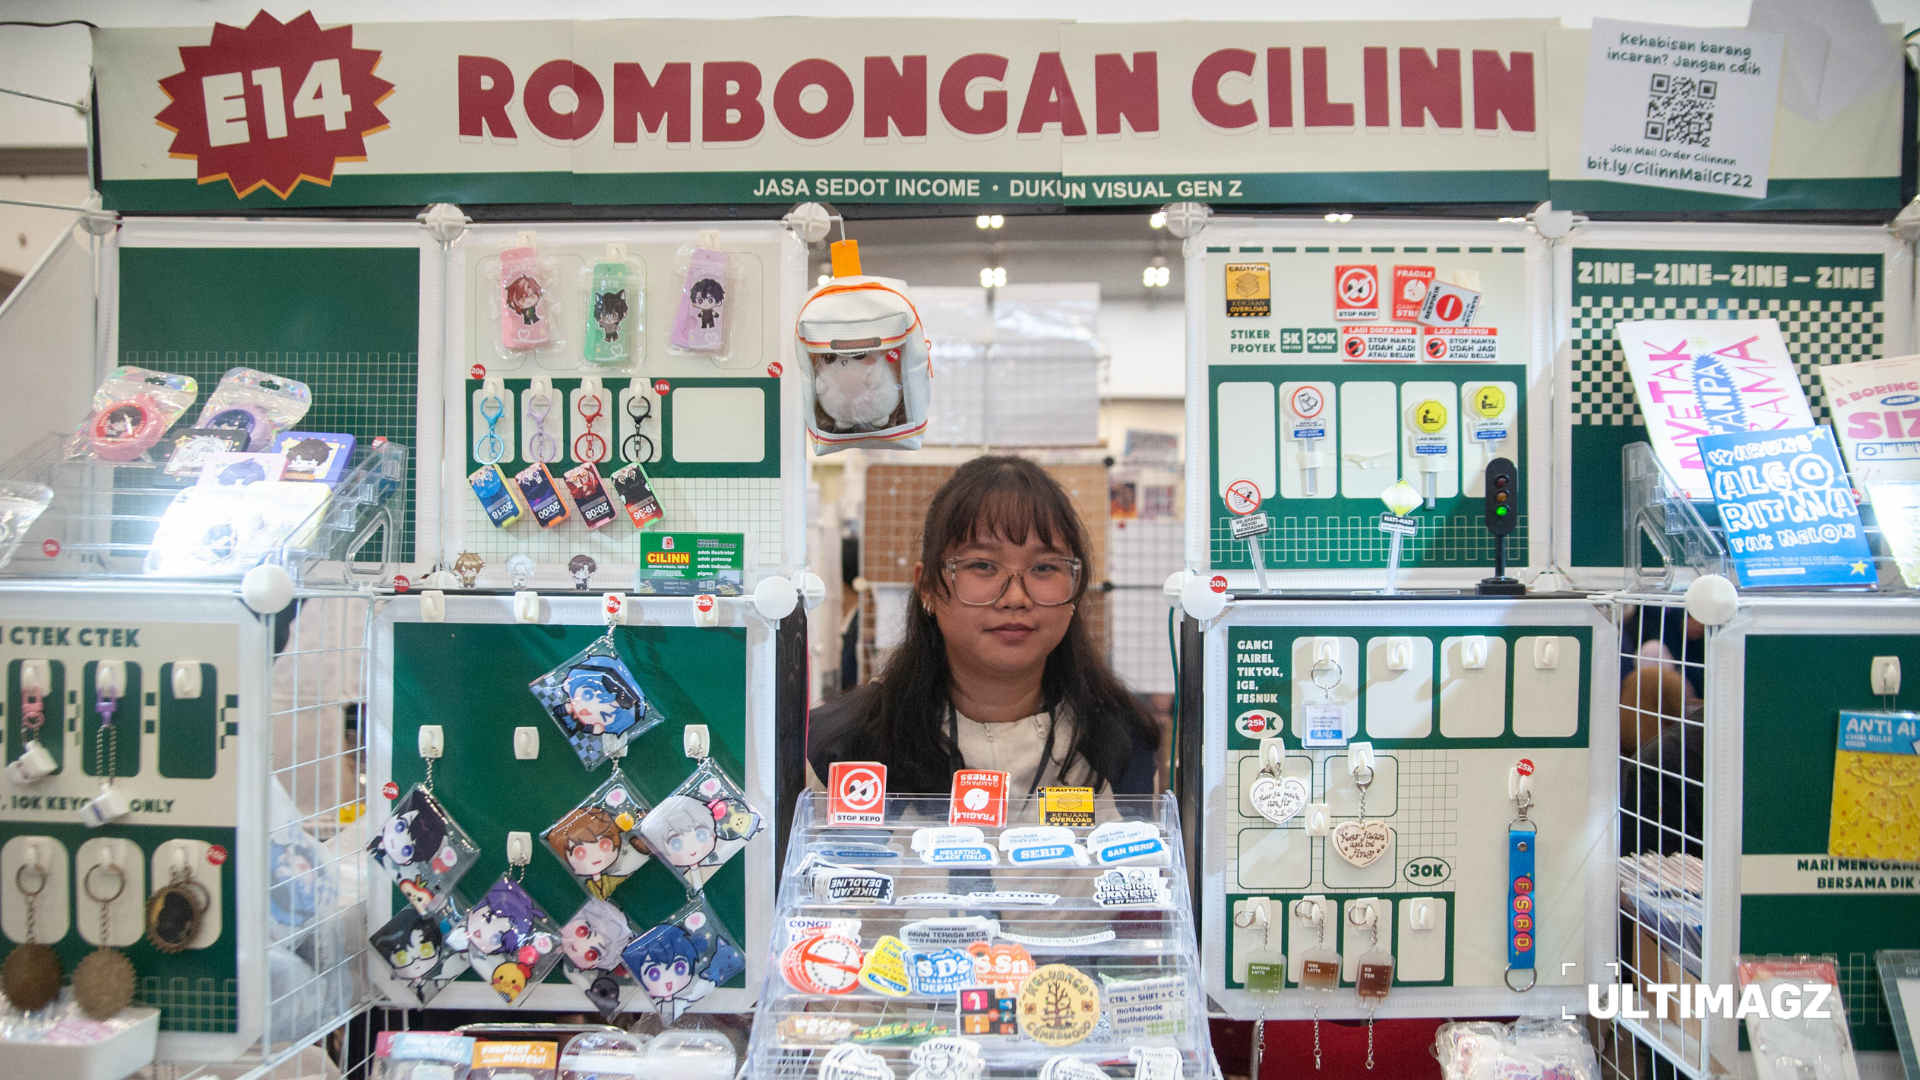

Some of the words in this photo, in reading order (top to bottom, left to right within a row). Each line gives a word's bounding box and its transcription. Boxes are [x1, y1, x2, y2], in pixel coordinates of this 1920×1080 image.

[1620, 32, 1696, 51] Kehabisan
[1700, 41, 1752, 60] barang
[1607, 47, 1669, 66] incaran?
[1673, 55, 1726, 73] Jangan
[1729, 63, 1761, 76] cdih
[458, 50, 1158, 142] ROMBONGAN
[1192, 46, 1536, 132] CILINN
[202, 59, 352, 147] E14
[1610, 143, 1633, 154] Join
[1635, 146, 1658, 157] Mail
[1660, 149, 1691, 161] Order
[1587, 156, 1754, 188] bit.ly/CilinnMailCF22
[753, 178, 810, 197] JASA
[815, 178, 889, 197] SEDOT
[895, 178, 980, 197] INCOME
[1010, 179, 1086, 199] DUKUN
[1090, 180, 1172, 198] VISUAL
[1177, 180, 1225, 197] GEN
[1228, 180, 1243, 196] Z
[1464, 295, 1479, 327] ERTANYA
[1231, 330, 1270, 339] STIKER
[1282, 332, 1300, 344] 5K
[1307, 333, 1336, 344] 20K
[1231, 344, 1276, 353] PROYEK
[470, 367, 485, 376] 20k
[768, 364, 782, 377] 20k
[654, 383, 669, 391] 15k
[1835, 397, 1848, 408] A
[1849, 381, 1919, 402] BORING
[1708, 434, 1812, 466] WARUNG
[1715, 453, 1834, 500] ALGO
[537, 501, 561, 520] 20:00
[584, 502, 609, 520] 20:08
[633, 503, 657, 520] 19:36
[1718, 487, 1858, 532] RITMA
[1731, 533, 1774, 553] PAK
[1776, 523, 1856, 547] MELON
[647, 552, 690, 563] CILINN
[393, 579, 409, 588] 25k
[1210, 579, 1227, 588] 30k
[697, 599, 713, 607] 25k
[10, 626, 71, 647] CTEK
[77, 627, 141, 648] CTEK
[1237, 640, 1273, 650] GANCI
[1237, 653, 1274, 663] FAIREL
[1237, 667, 1283, 677] TIKTOK,
[1237, 680, 1258, 691] IGE,
[1237, 693, 1278, 703] FESNUK
[1248, 719, 1264, 727] 25k
[1845, 718, 1892, 735] ANTI
[1897, 719, 1915, 737] AI
[1868, 735, 1893, 743] RULER
[1517, 764, 1534, 773] 25k
[382, 786, 399, 795] 20k
[11, 795, 43, 810] 10K
[129, 798, 176, 813] ONLY
[957, 811, 995, 821] FRAGILE
[1021, 848, 1065, 859] SERIF
[1107, 847, 1127, 857] SAN
[1128, 842, 1155, 853] SERIF
[962, 853, 987, 861] ITALIC
[1797, 858, 1834, 871] MARI
[1410, 864, 1443, 878] 30K
[831, 878, 883, 888] DEADLINE
[1817, 876, 1888, 889] BERSAMA
[1890, 876, 1914, 889] DIK
[833, 888, 880, 898] DIKEJAR
[1515, 880, 1532, 948] FSRD
[1026, 971, 1089, 996] KELUARGA
[1138, 992, 1158, 1001] SHIFT
[928, 1043, 955, 1051] LOVE
